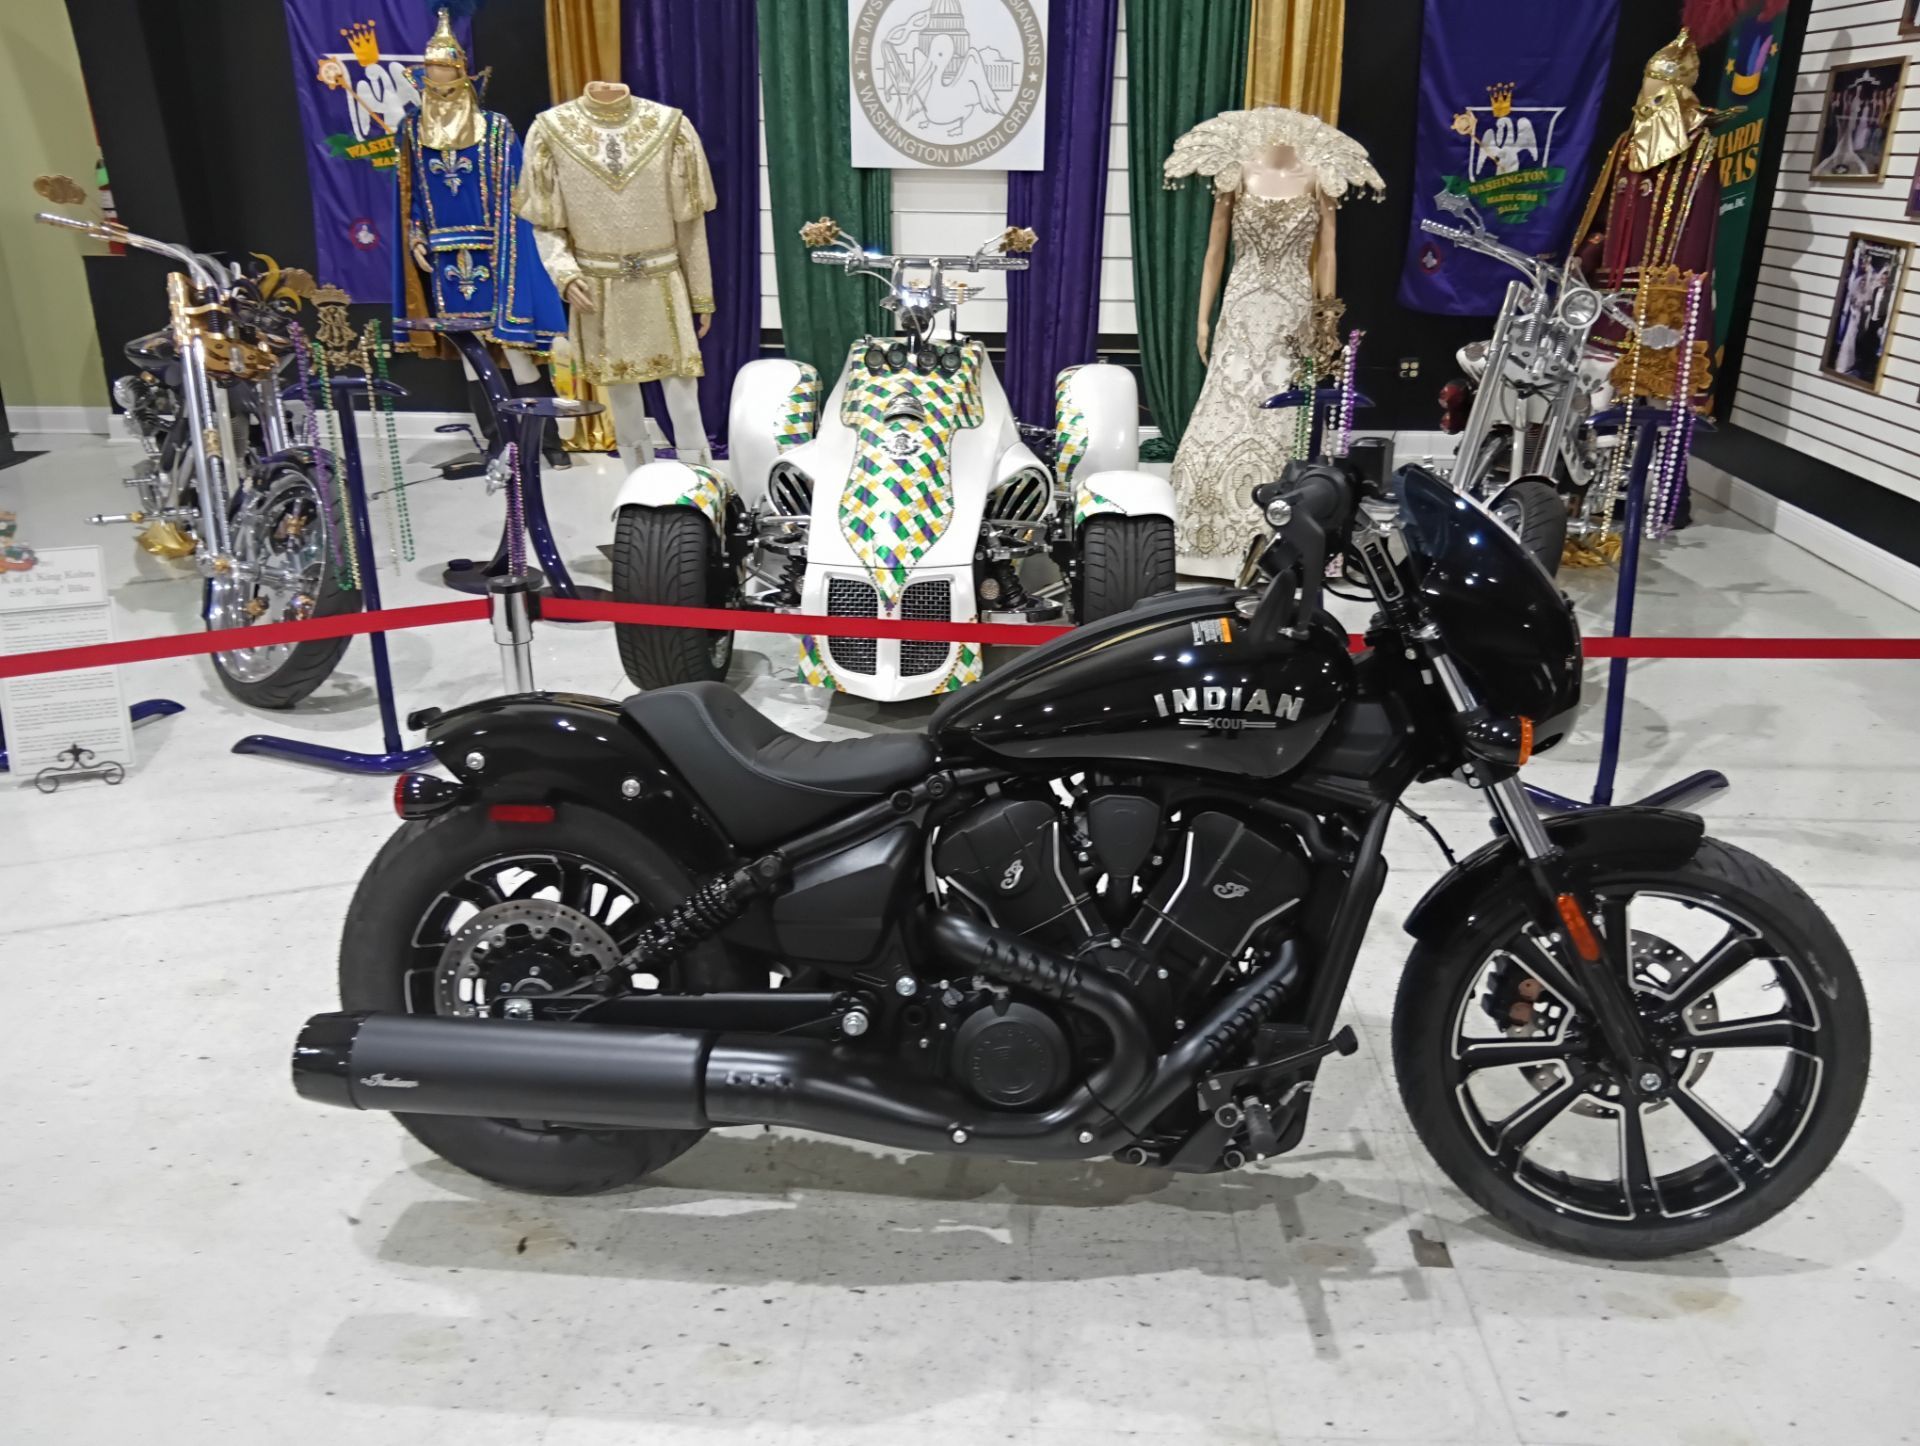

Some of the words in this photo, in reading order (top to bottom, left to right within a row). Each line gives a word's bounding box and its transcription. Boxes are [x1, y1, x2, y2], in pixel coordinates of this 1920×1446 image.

[854, 35, 869, 64] The
[859, 86, 949, 163] WASHINGTON
[953, 134, 1005, 162] MARDI
[1003, 88, 1036, 135] GRAS
[1469, 170, 1548, 194] WASHINGTON
[1719, 147, 1760, 187] RAS
[1153, 686, 1304, 721] INDIAN
[1208, 717, 1247, 730] SCOUT
